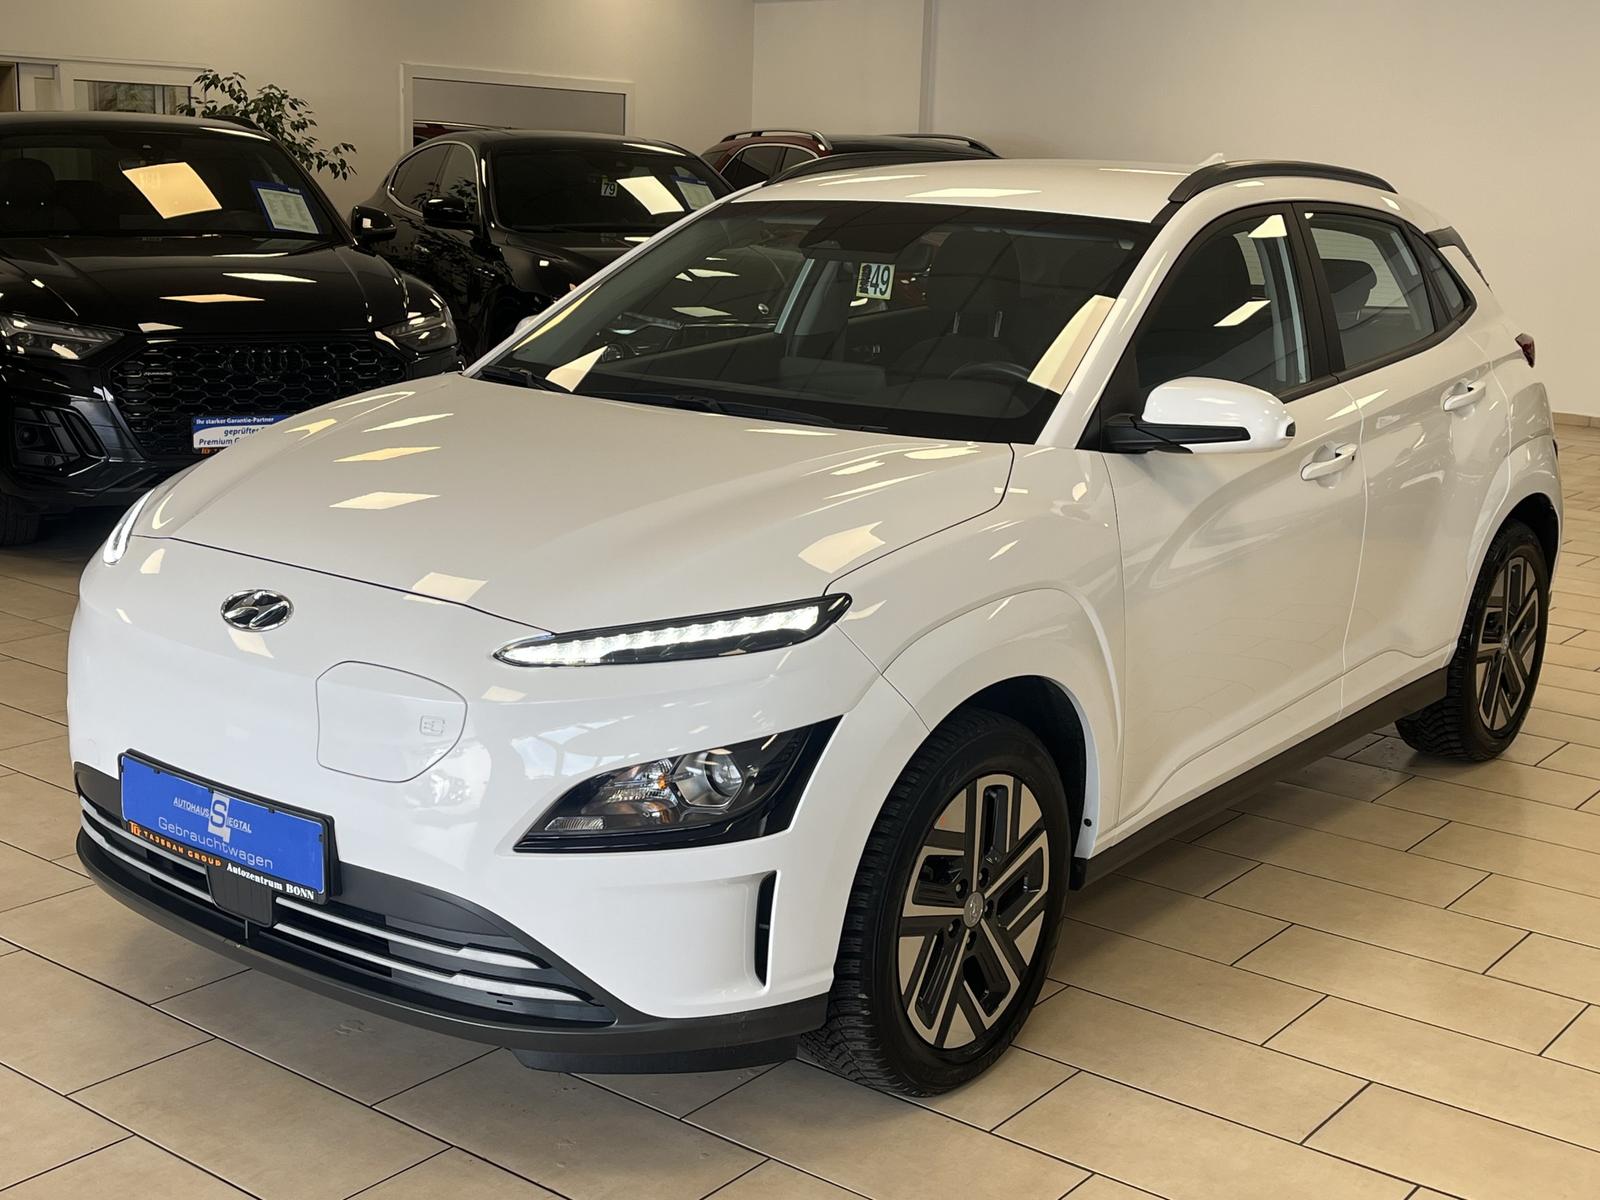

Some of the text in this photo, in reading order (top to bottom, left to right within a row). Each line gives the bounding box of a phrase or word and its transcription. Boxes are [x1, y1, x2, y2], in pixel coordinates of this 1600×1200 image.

[604, 183, 616, 195] 79
[227, 416, 274, 424] Garantie-Partner
[199, 438, 232, 446] Premium
[173, 797, 210, 818] AUTOHAUS
[158, 816, 273, 870] Gebrauchtwagen
[187, 850, 222, 867] GROUP
[226, 863, 315, 900] Autozentrum BONN
